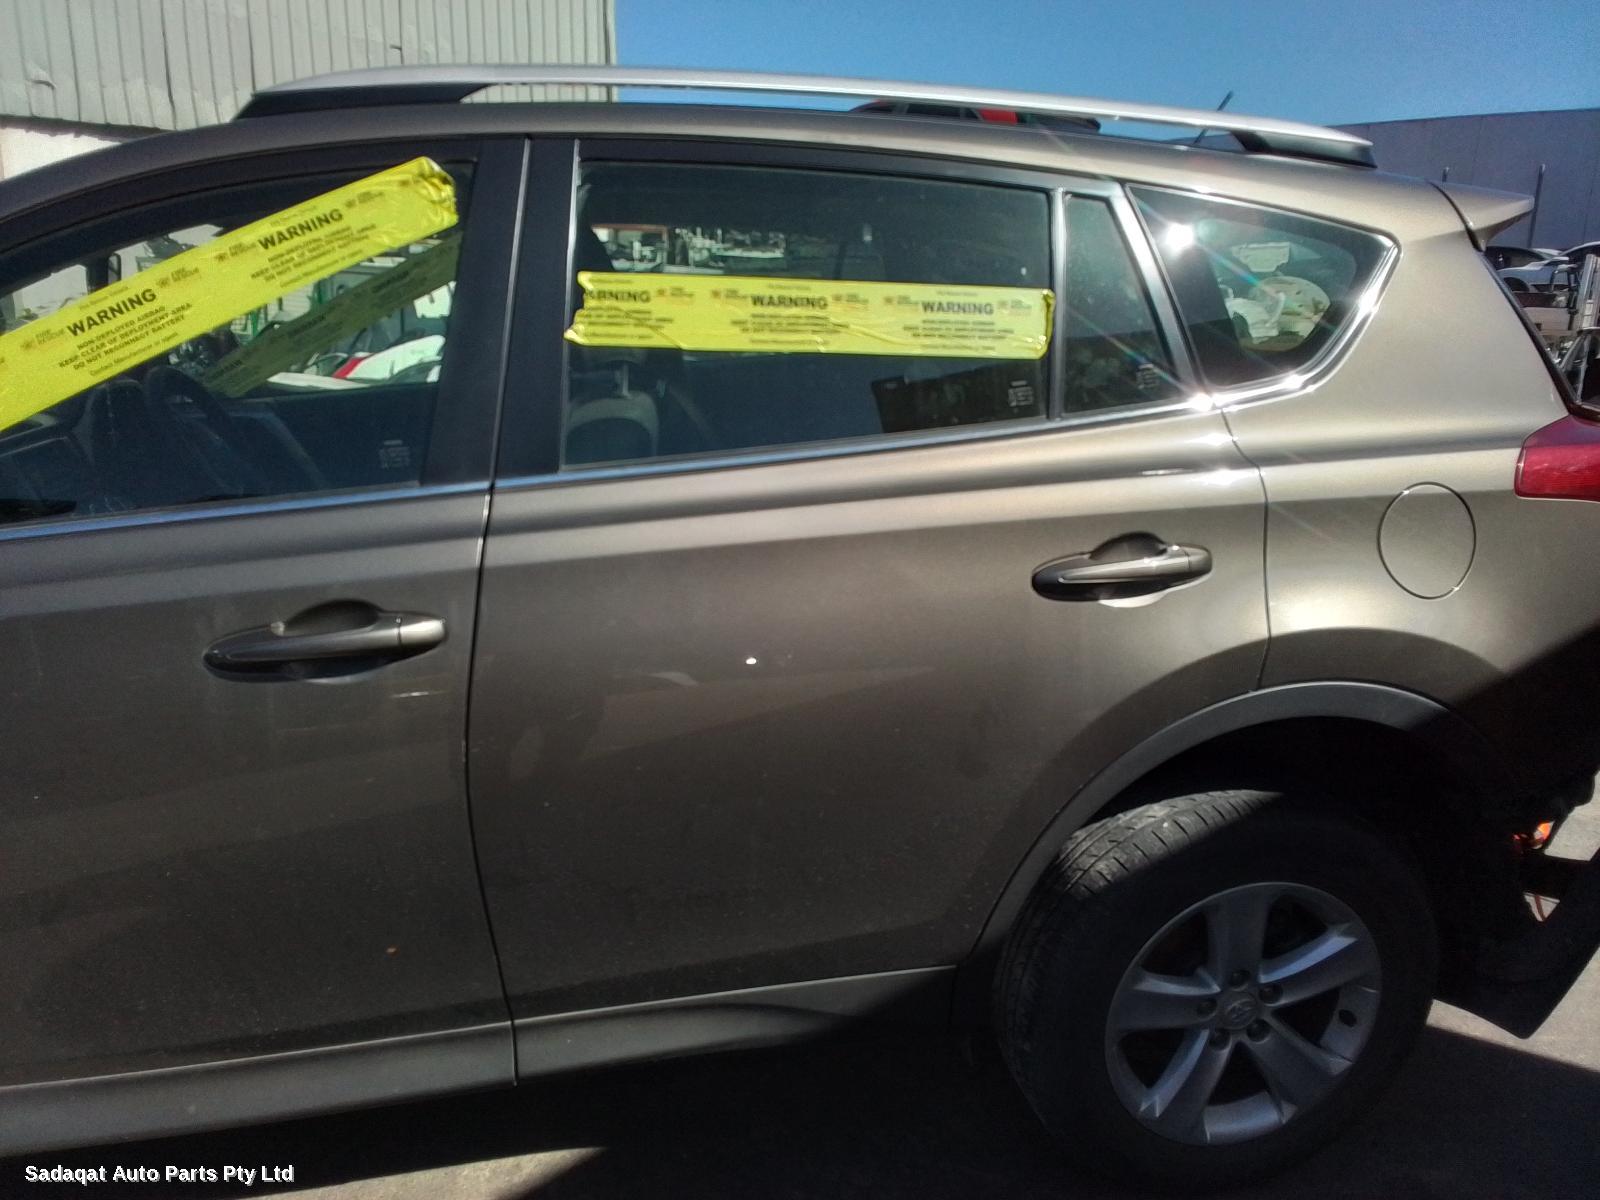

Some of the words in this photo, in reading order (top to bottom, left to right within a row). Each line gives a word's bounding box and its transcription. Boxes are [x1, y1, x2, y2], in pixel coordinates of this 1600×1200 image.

[258, 208, 343, 250] WARNING
[66, 289, 157, 337] WARNING
[584, 289, 651, 303] ARNING
[751, 296, 829, 310] WARNING
[921, 301, 994, 315] WARNING
[72, 361, 85, 370] DO
[84, 352, 102, 364] NOT
[150, 314, 185, 333] BATTERY
[79, 341, 107, 357] CLEAR
[106, 336, 118, 345] OF
[119, 313, 169, 338] DEPLOYMENT
